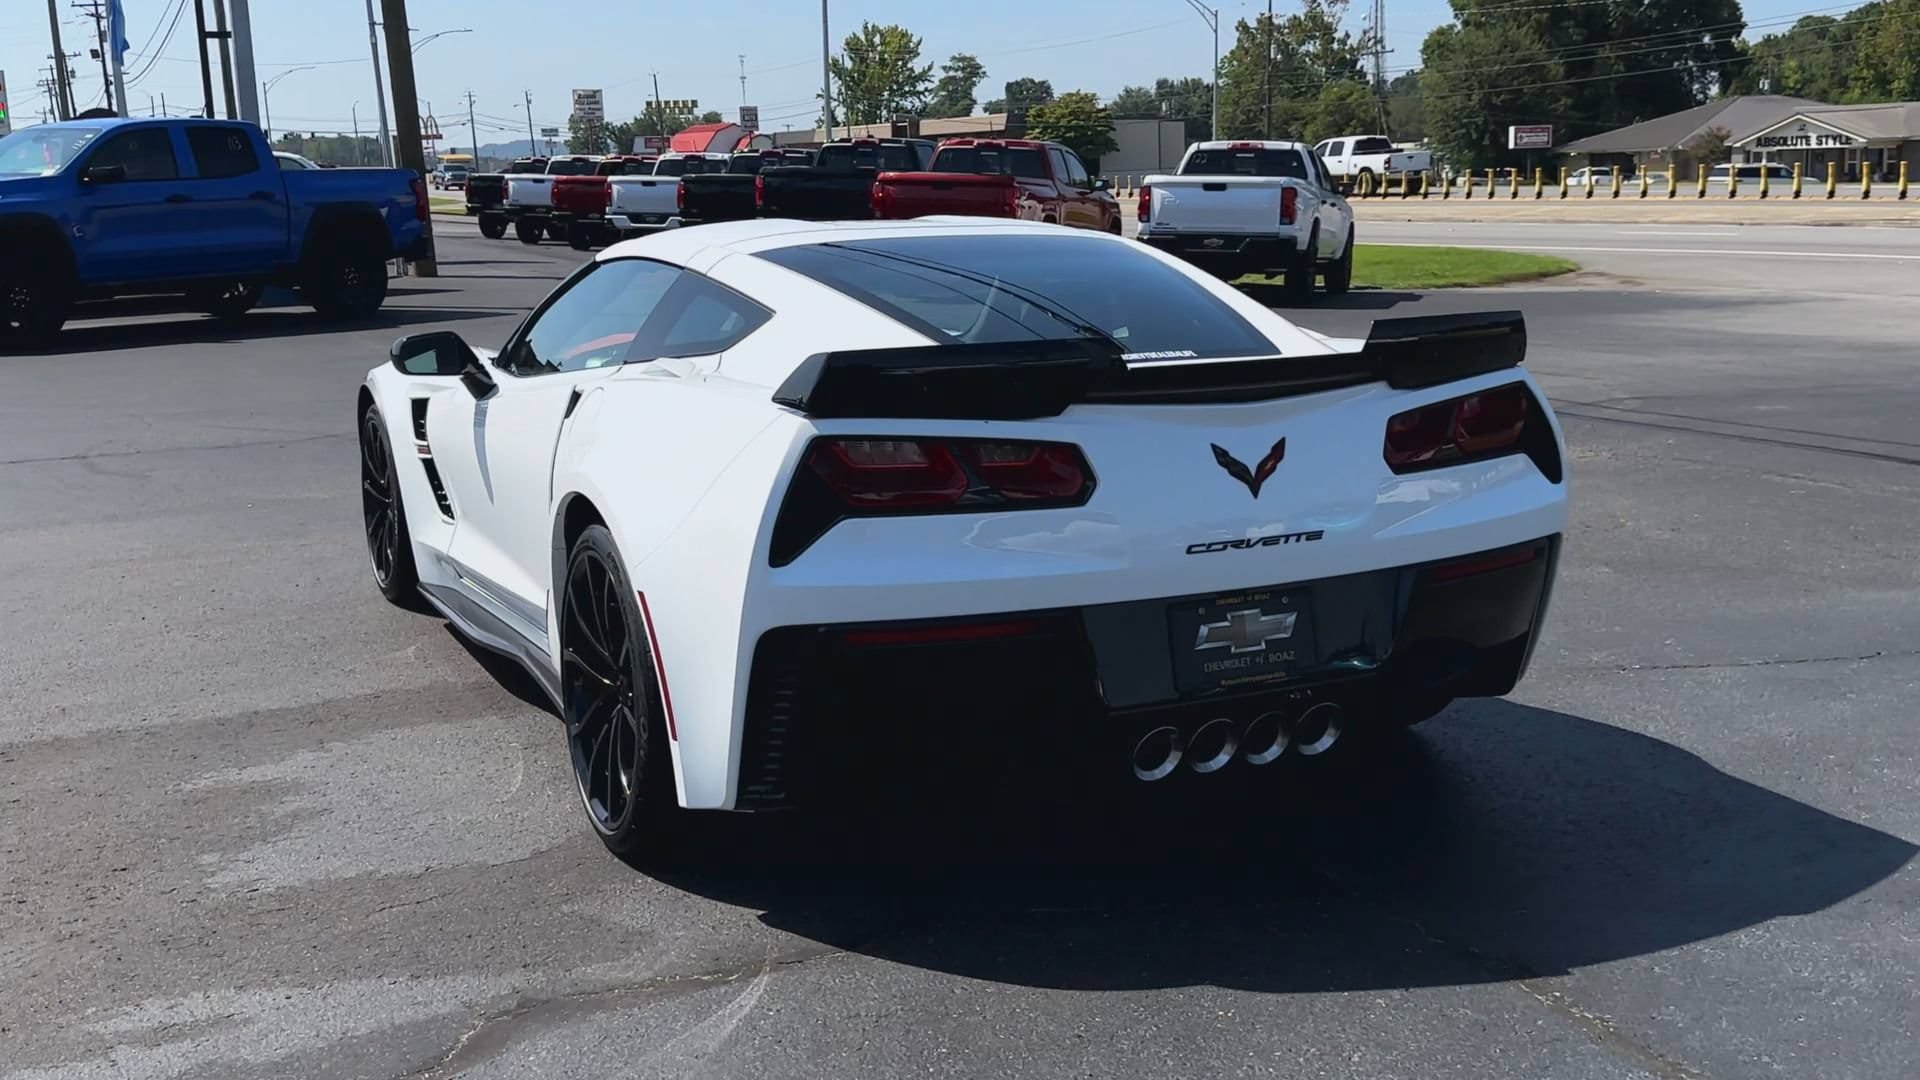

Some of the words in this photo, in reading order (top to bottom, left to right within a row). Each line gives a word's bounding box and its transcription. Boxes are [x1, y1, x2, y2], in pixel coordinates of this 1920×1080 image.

[1756, 135, 1811, 147] ABSOLUTE
[1816, 134, 1852, 146] STYLE
[1186, 530, 1325, 555] CORVETTE
[1204, 656, 1250, 673] CHEVROLET
[1268, 651, 1296, 664] BOAZ
